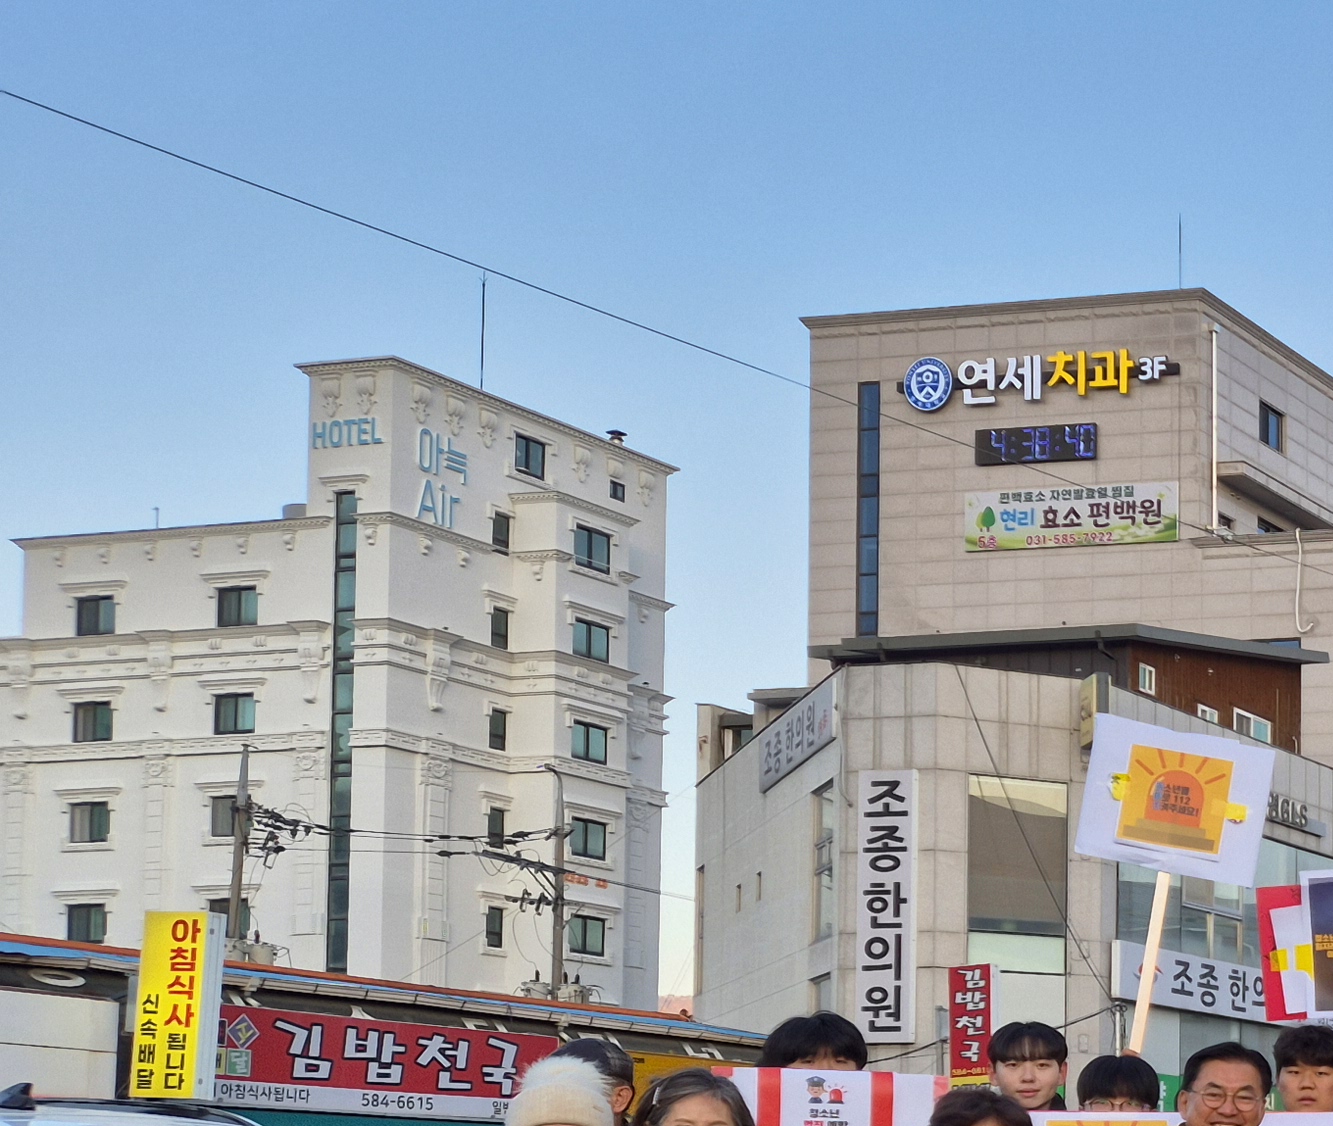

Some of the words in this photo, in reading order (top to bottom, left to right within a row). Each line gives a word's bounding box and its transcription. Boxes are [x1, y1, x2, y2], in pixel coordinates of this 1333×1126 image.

[1137, 355, 1170, 381] 3F
[312, 417, 383, 449] HOTEL
[417, 479, 461, 529] Air
[999, 508, 1036, 532] 현리
[1039, 505, 1083, 530] 효소
[1086, 498, 1163, 529] 편백원
[1026, 531, 1113, 546] 031-585-7922
[1173, 796, 1191, 806] 112
[1171, 959, 1219, 1008] 조종
[954, 967, 988, 1064] 김밥천국
[136, 994, 161, 1090] 신속배달
[273, 1018, 519, 1097] 김밥천국
[220, 1083, 311, 1105] 아침식사됩니다
[361, 1093, 434, 1112] 584-6615
